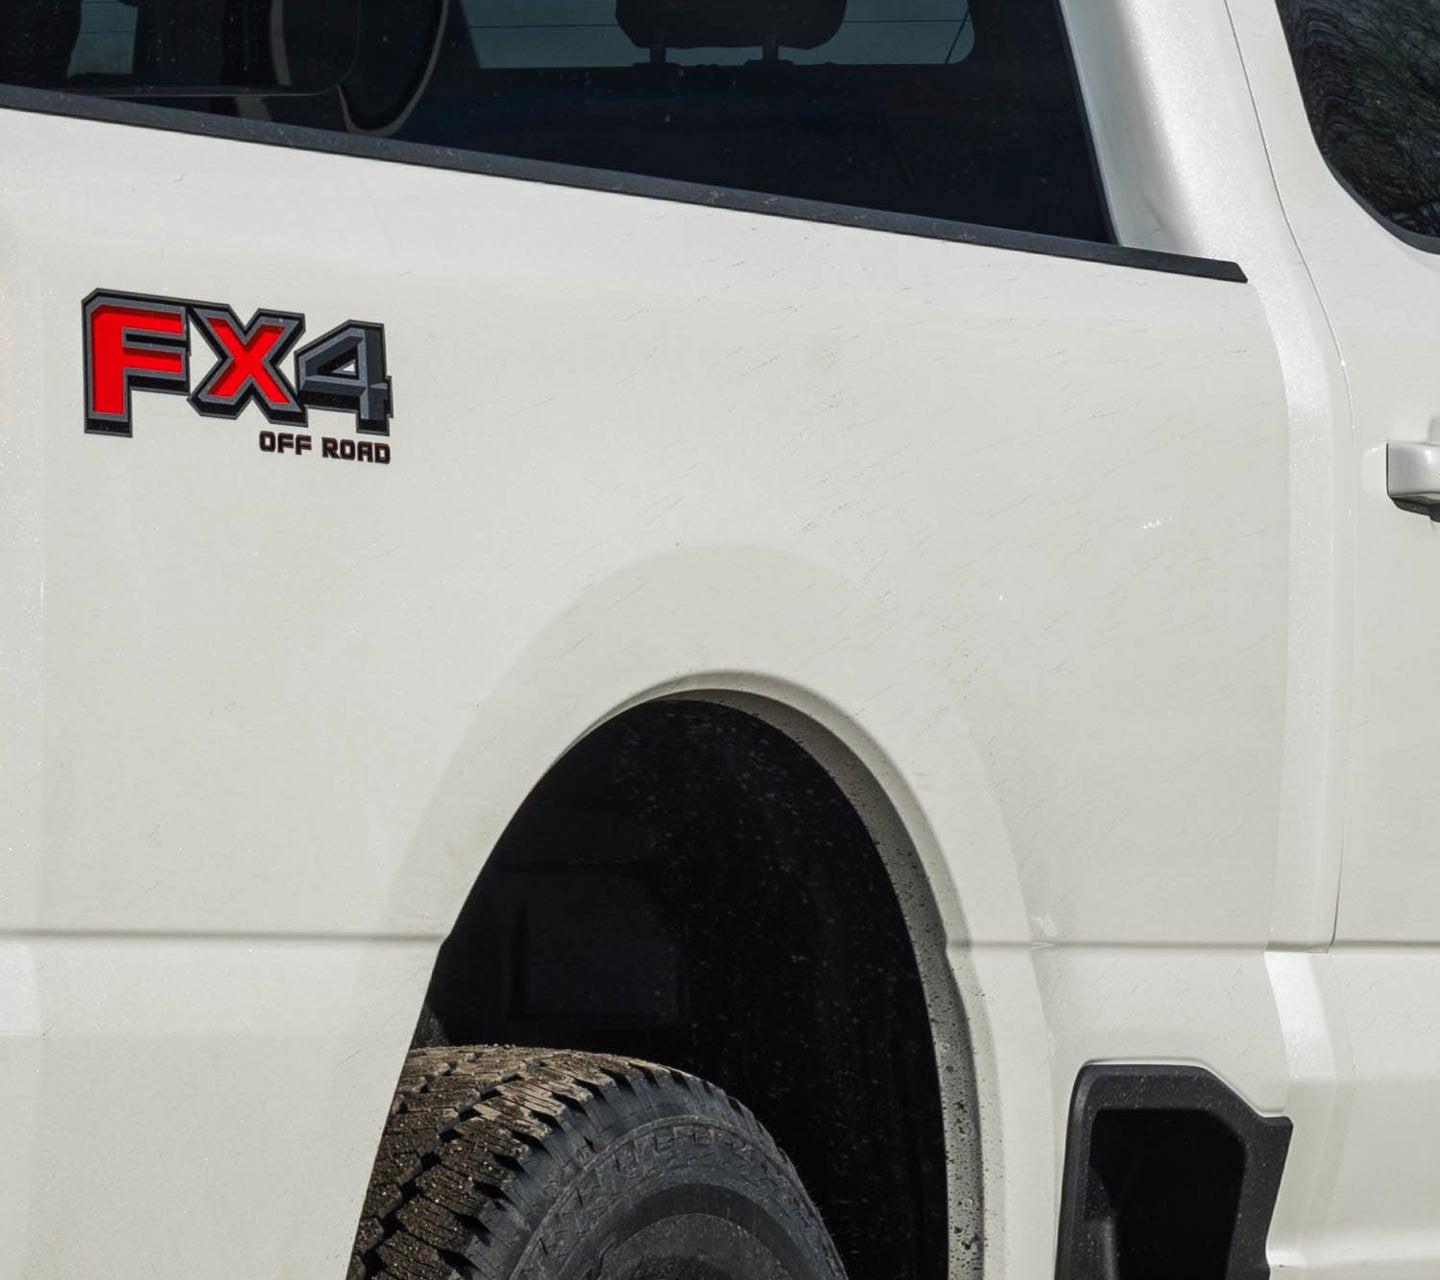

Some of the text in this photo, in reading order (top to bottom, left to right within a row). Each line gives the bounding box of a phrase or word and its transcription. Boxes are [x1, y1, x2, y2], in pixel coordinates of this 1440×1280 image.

[81, 288, 393, 438] FX4
[259, 431, 391, 464] OFF ROAD
